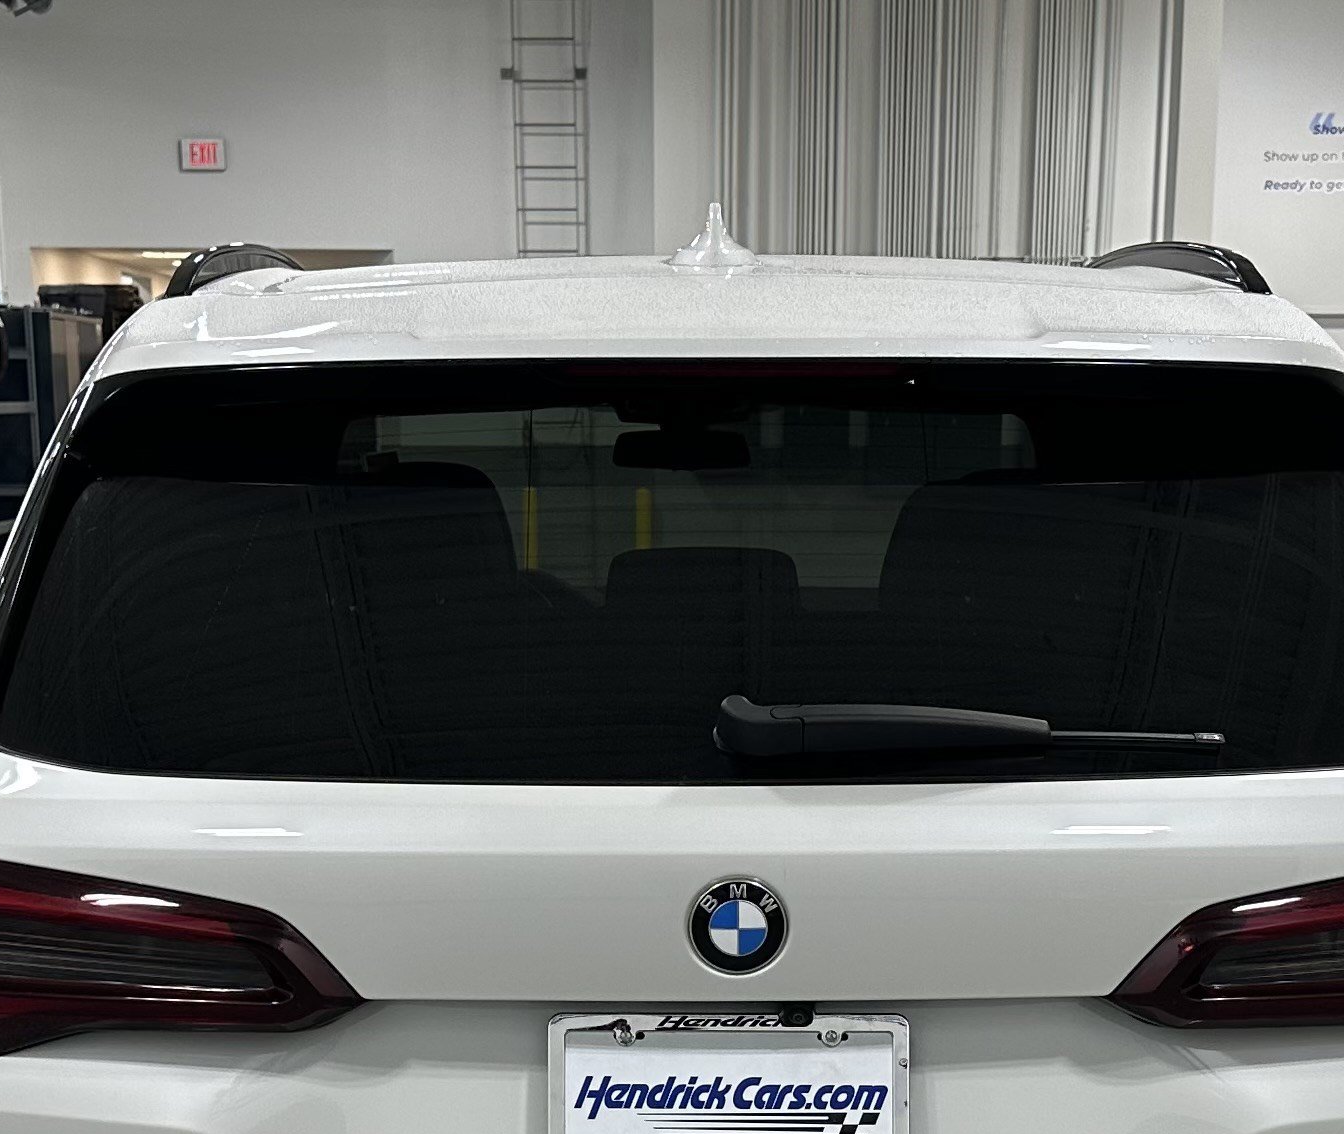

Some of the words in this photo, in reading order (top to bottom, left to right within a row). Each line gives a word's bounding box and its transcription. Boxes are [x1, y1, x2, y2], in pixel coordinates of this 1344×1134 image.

[189, 143, 218, 165] EXIT
[1263, 150, 1299, 162] Show
[1302, 152, 1319, 163] up
[1322, 152, 1338, 162] on
[1264, 179, 1306, 192] Ready
[1310, 180, 1323, 190] to
[699, 883, 778, 913] BMW
